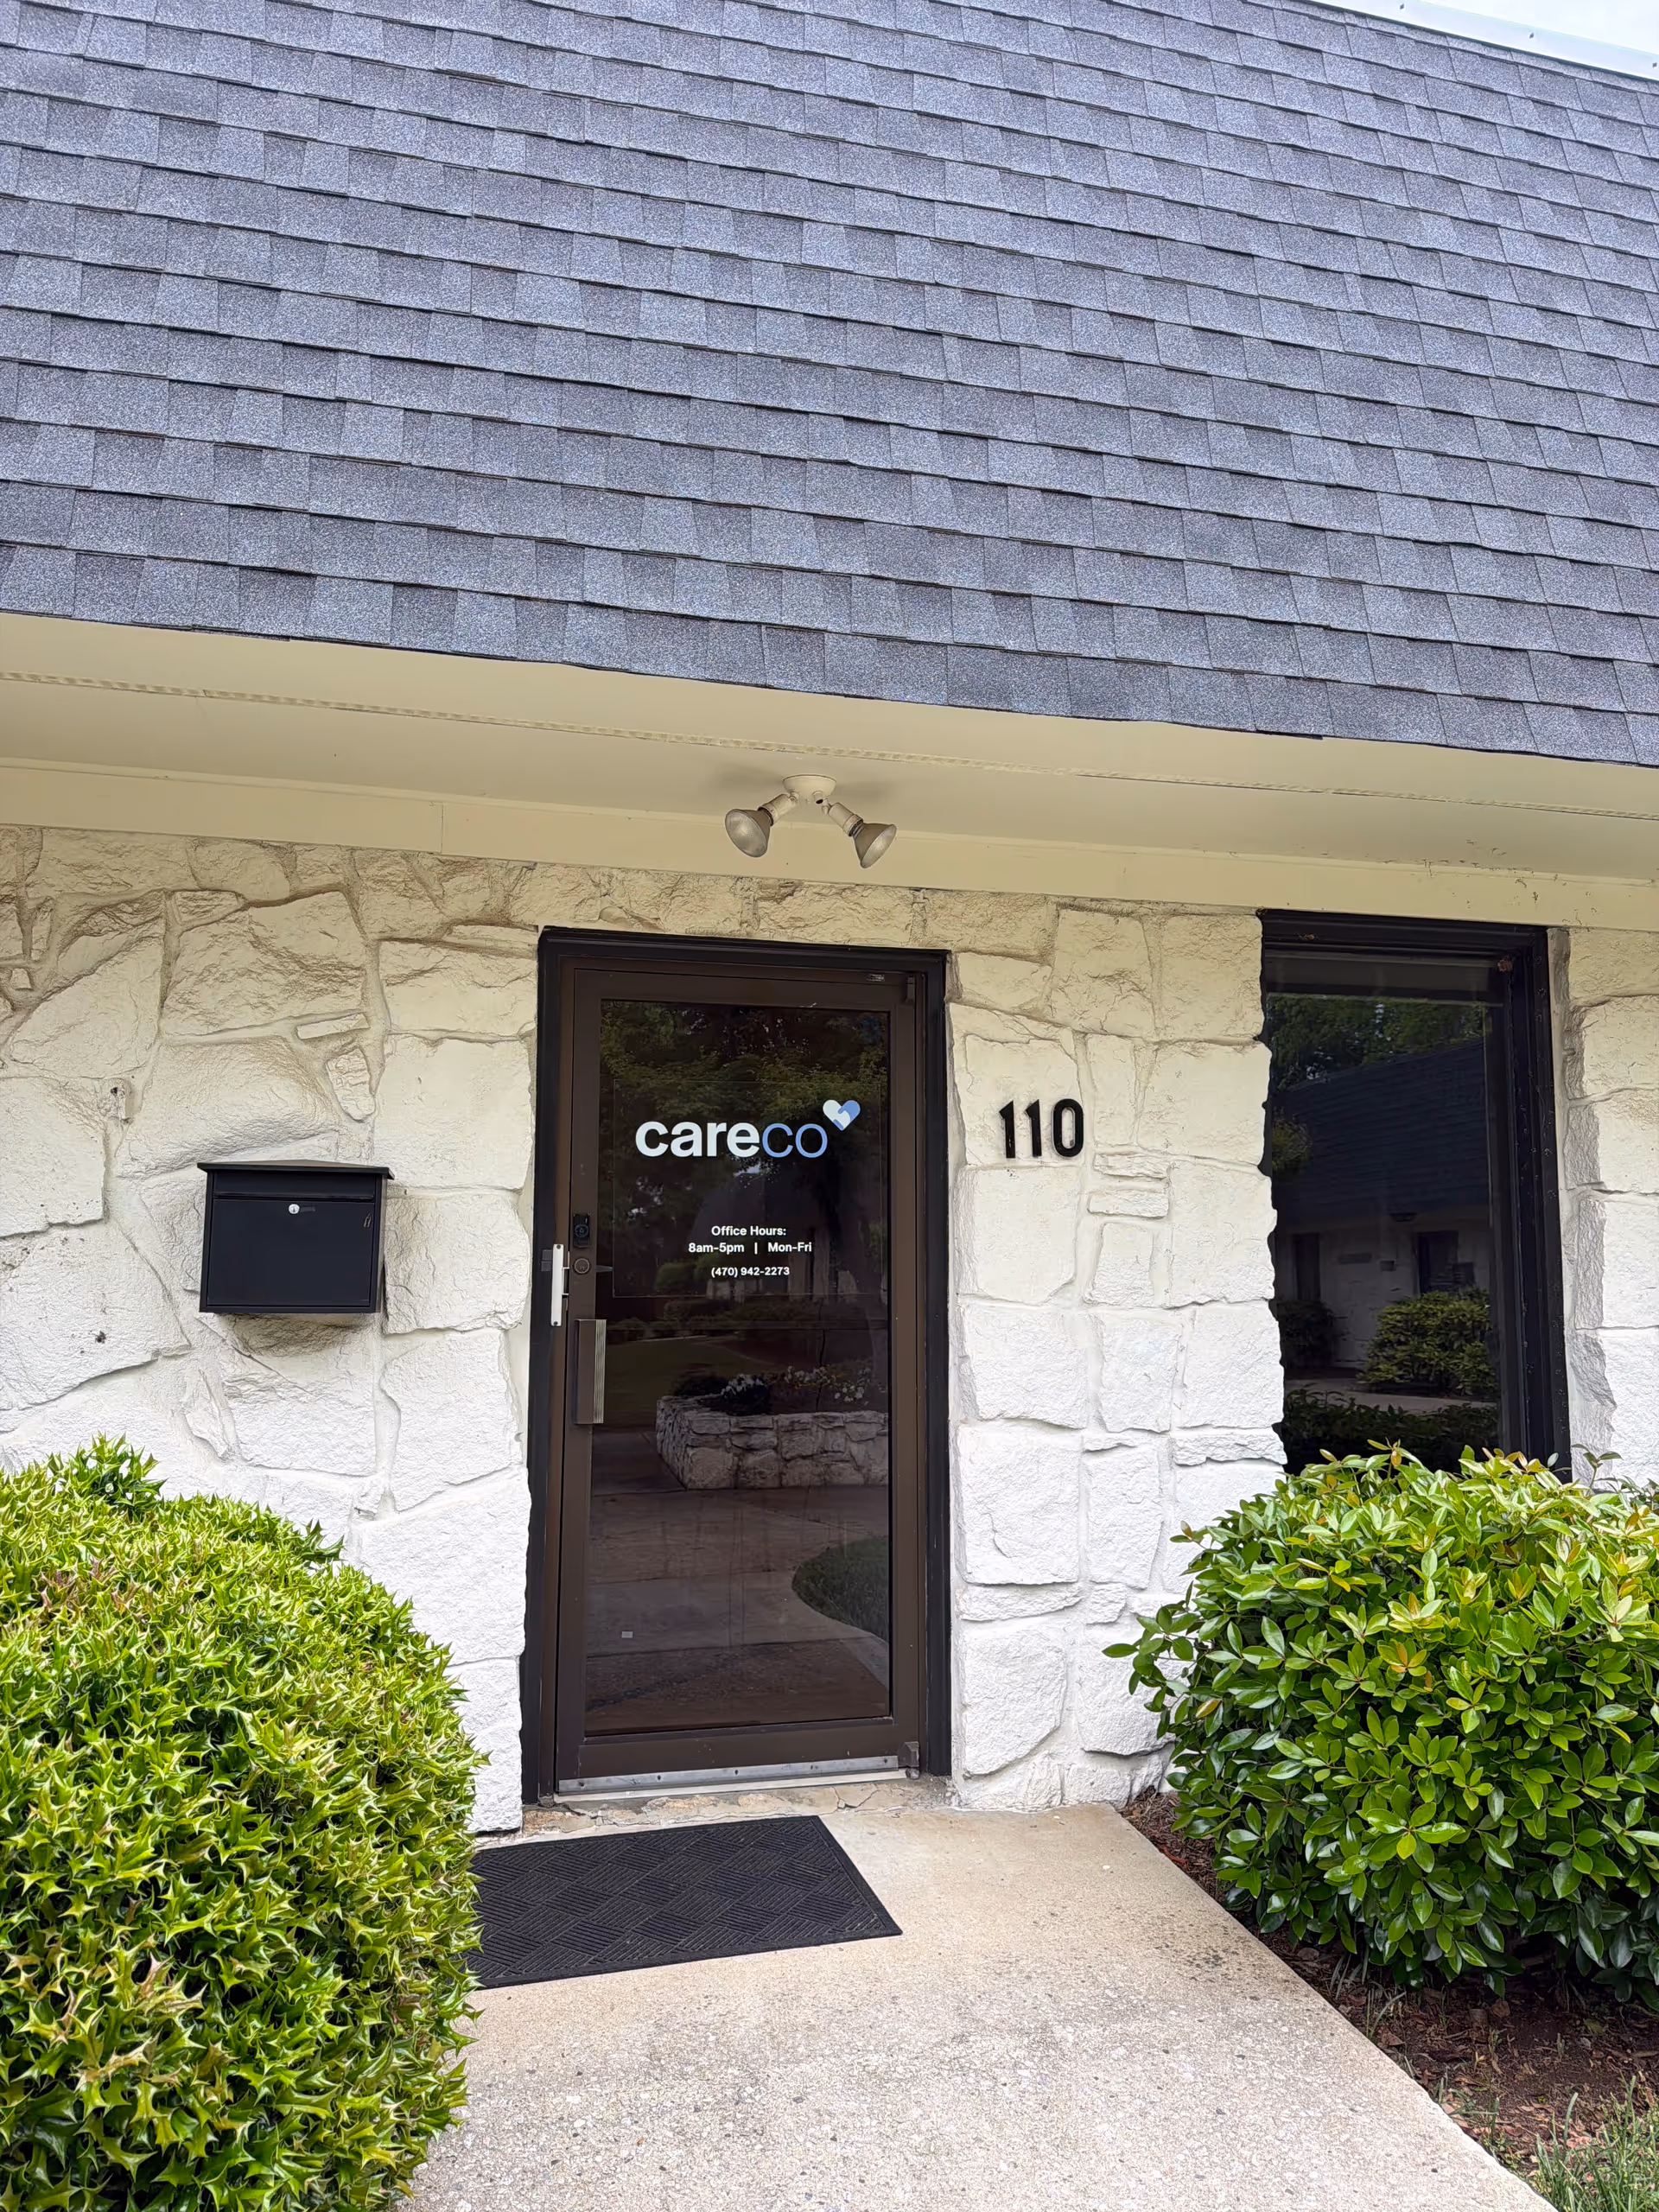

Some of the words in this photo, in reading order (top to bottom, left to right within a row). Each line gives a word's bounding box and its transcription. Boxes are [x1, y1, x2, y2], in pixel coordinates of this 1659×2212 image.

[998, 1098, 1084, 1159] 110
[635, 1121, 828, 1159] careco
[711, 1225, 747, 1236] Office
[750, 1225, 786, 1236] Hours:
[688, 1243, 745, 1255] 8am-5pm
[767, 1242, 812, 1253] Mon-Fri
[711, 1267, 738, 1278] (470)
[741, 1267, 790, 1276] 942-2273
